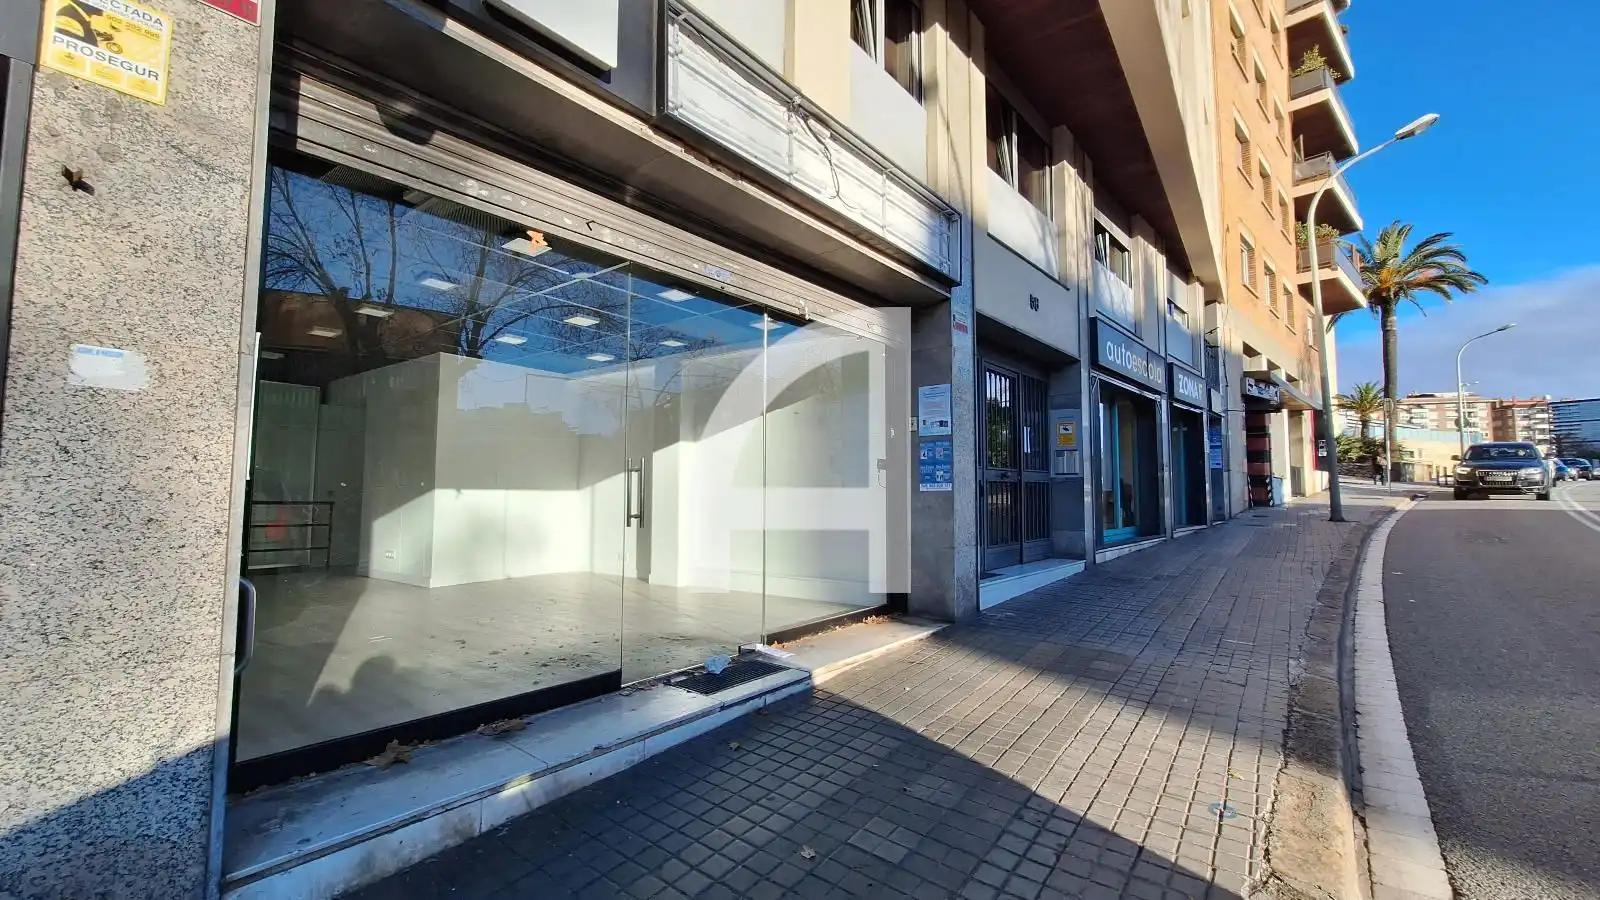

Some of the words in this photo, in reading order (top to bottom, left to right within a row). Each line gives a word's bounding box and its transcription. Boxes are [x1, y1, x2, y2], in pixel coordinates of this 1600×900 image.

[52, 35, 160, 81] PROSEGUR
[1106, 341, 1162, 383] autoescola
[1178, 374, 1199, 400] ZONA
